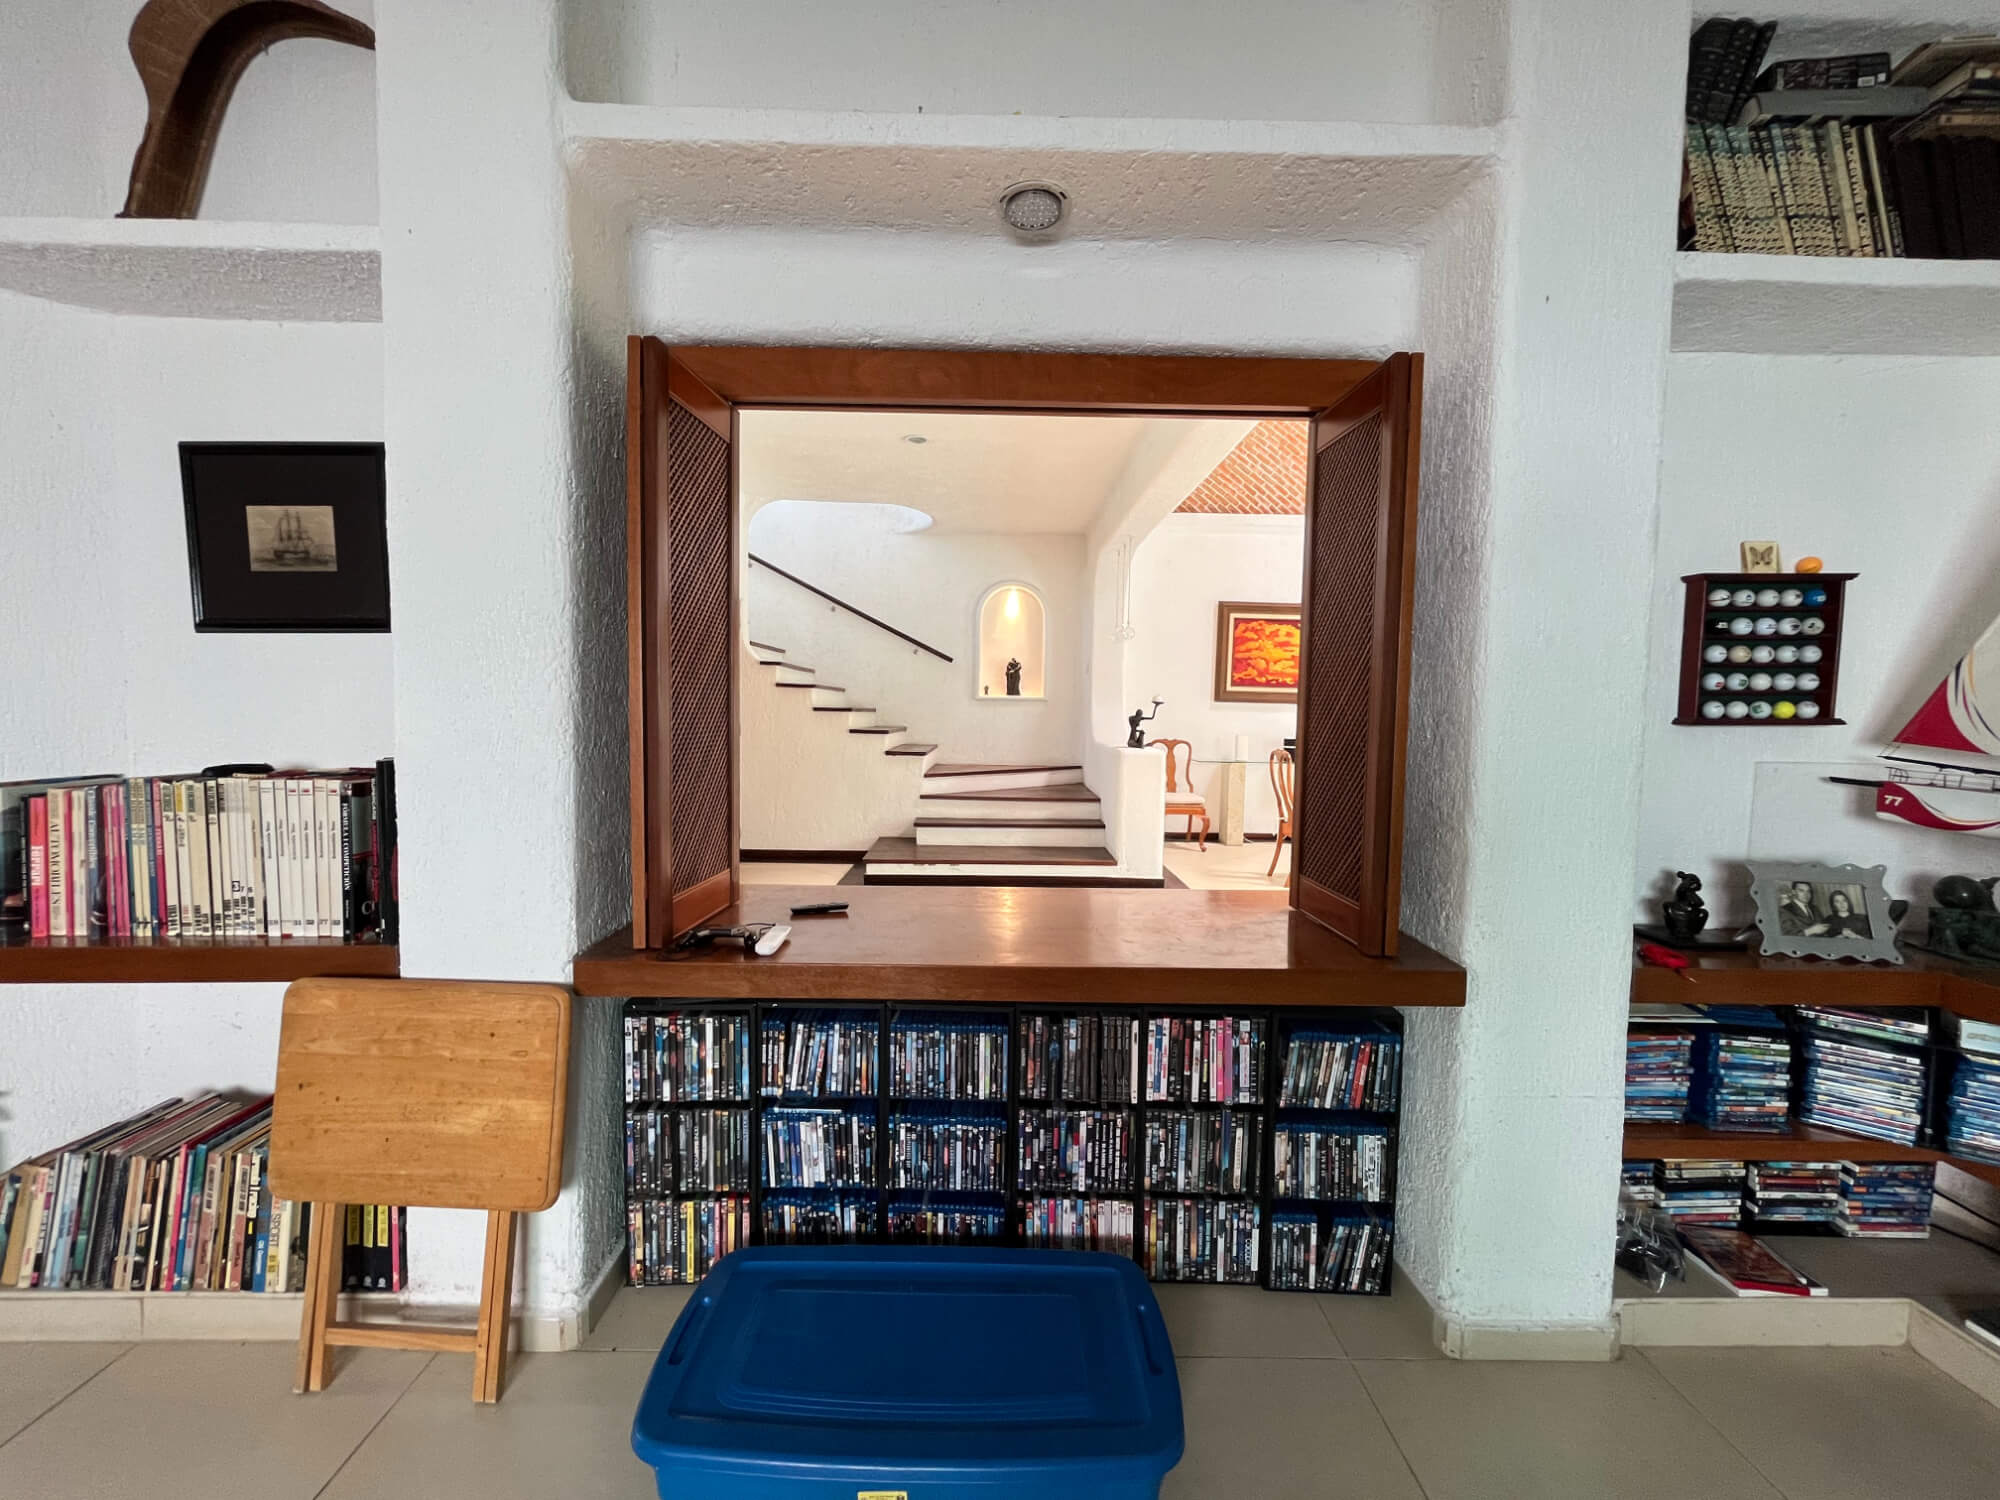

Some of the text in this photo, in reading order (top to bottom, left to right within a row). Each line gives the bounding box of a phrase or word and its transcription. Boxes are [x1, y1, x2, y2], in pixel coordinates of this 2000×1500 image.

[1884, 795, 1904, 806] 77
[30, 845, 44, 885] Ferrari
[49, 823, 60, 904] AUTOMOBILES
[270, 1213, 281, 1247] SPORT
